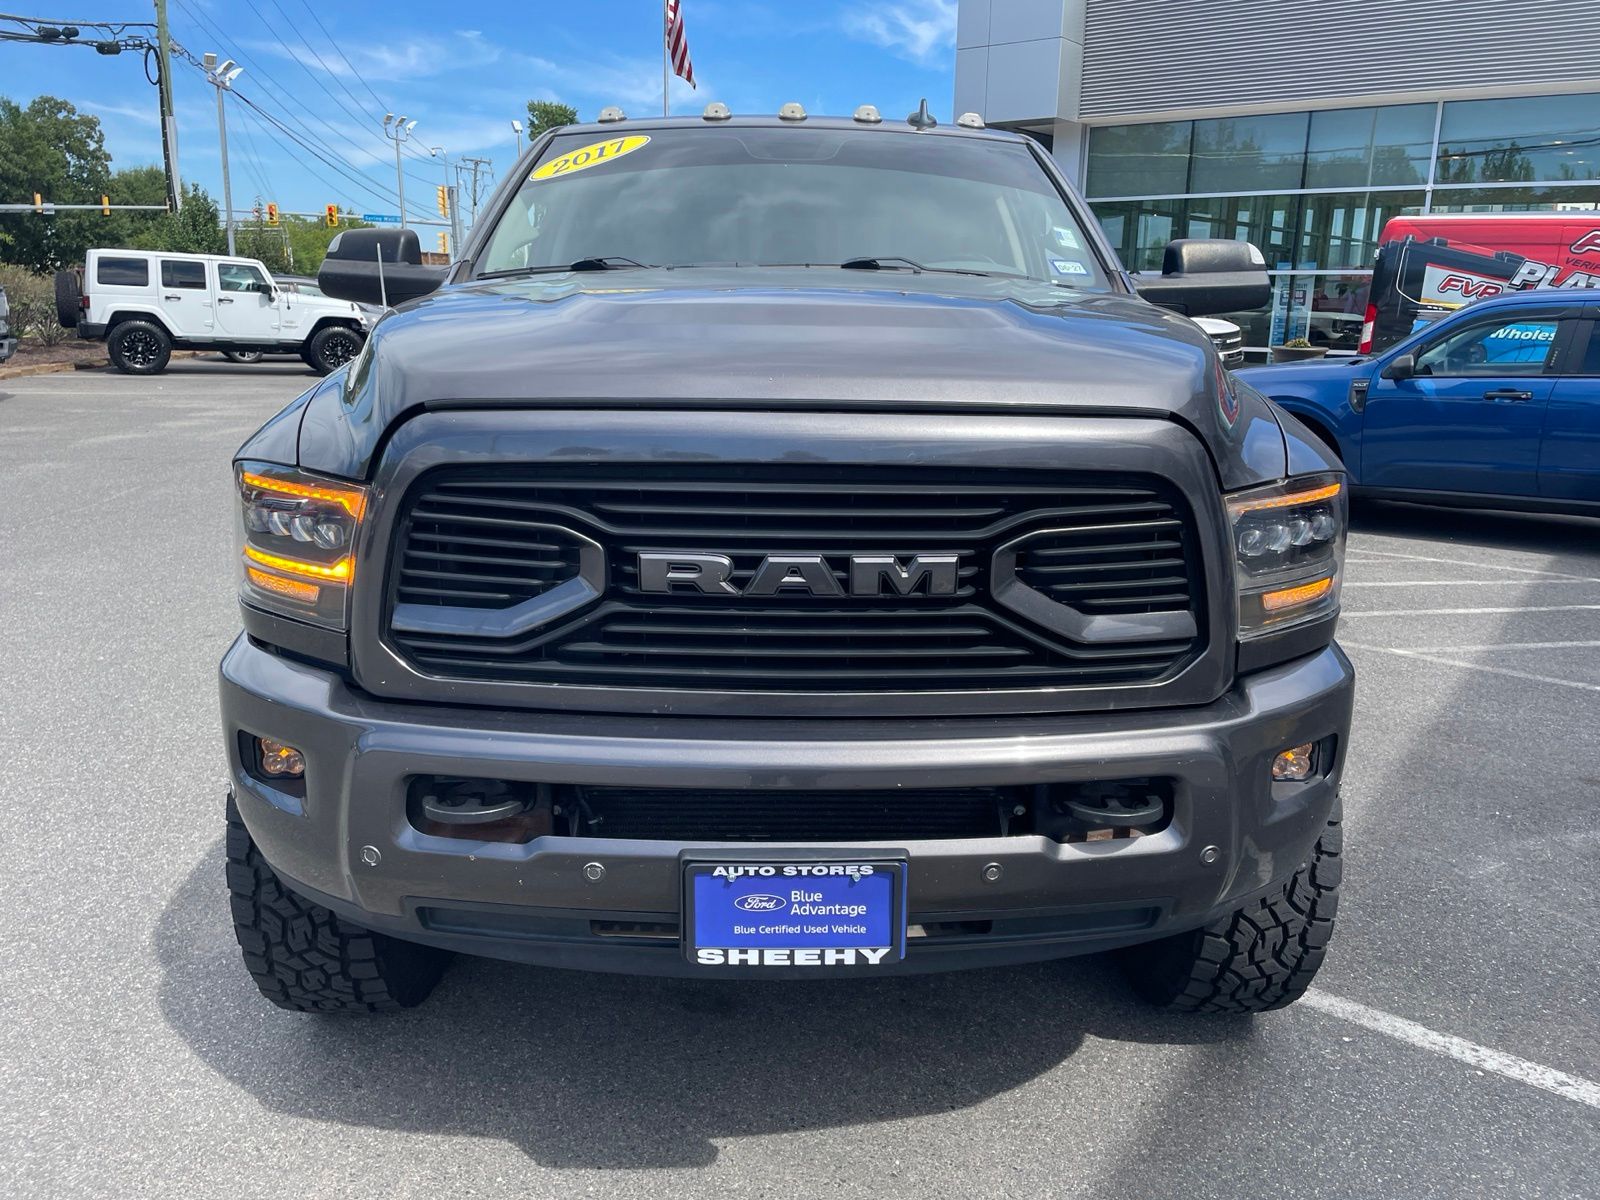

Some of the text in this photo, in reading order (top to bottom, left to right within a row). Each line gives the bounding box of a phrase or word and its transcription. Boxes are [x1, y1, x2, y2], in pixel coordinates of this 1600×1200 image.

[553, 140, 625, 175] 2017
[638, 551, 959, 598] RAM
[712, 865, 874, 876] AUTO STORES
[742, 895, 778, 911] Ford
[791, 890, 823, 902] Blue
[790, 904, 867, 917] Advantage
[734, 924, 867, 934] Blue Certified Used Vehicle
[697, 948, 891, 966] SHEEHY
